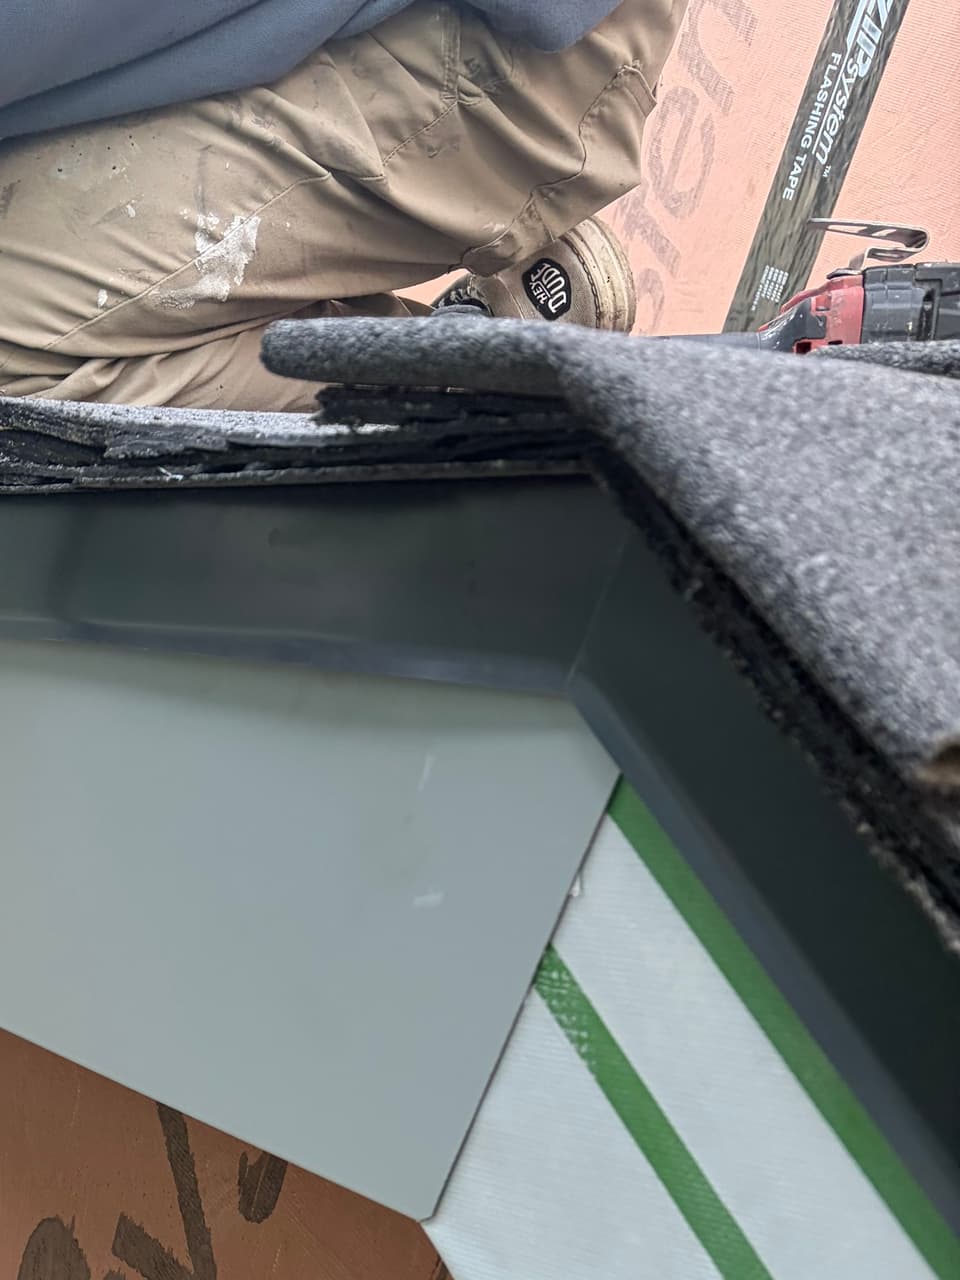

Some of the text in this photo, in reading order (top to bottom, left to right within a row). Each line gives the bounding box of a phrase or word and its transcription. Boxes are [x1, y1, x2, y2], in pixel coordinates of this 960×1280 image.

[783, 52, 842, 201] FLASHING TAPE
[530, 281, 548, 304] HEY
[531, 263, 567, 313] DUDE
